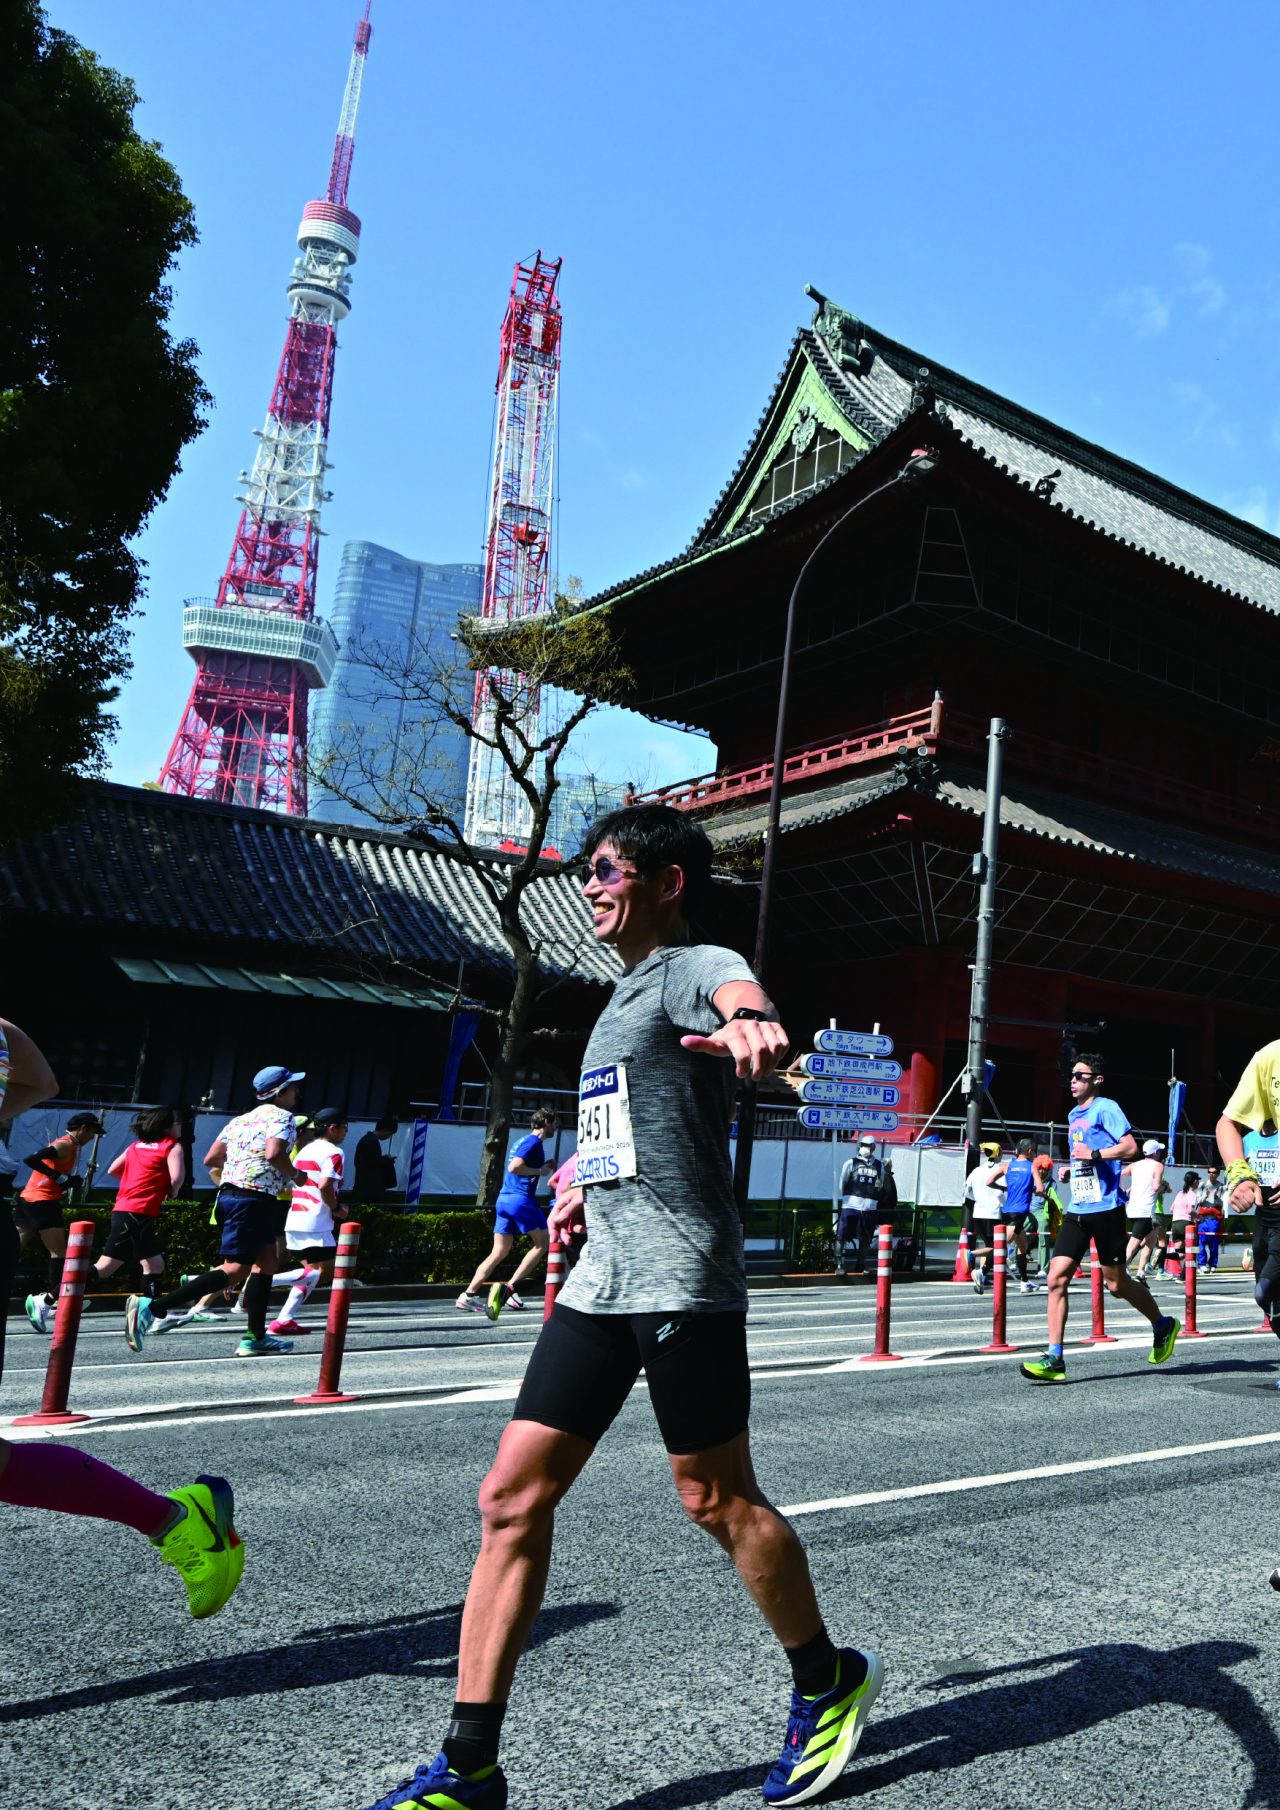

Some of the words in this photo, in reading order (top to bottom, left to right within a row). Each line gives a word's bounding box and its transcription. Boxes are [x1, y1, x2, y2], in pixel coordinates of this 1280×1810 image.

[826, 1033, 874, 1043] 東京タワー
[836, 1042, 849, 1050] Tokyo
[828, 1059, 883, 1070] 地下鉄御成門駅
[826, 1084, 880, 1096] 地下鉄芝公園駅
[824, 1110, 880, 1121] 地下鉄大門駅
